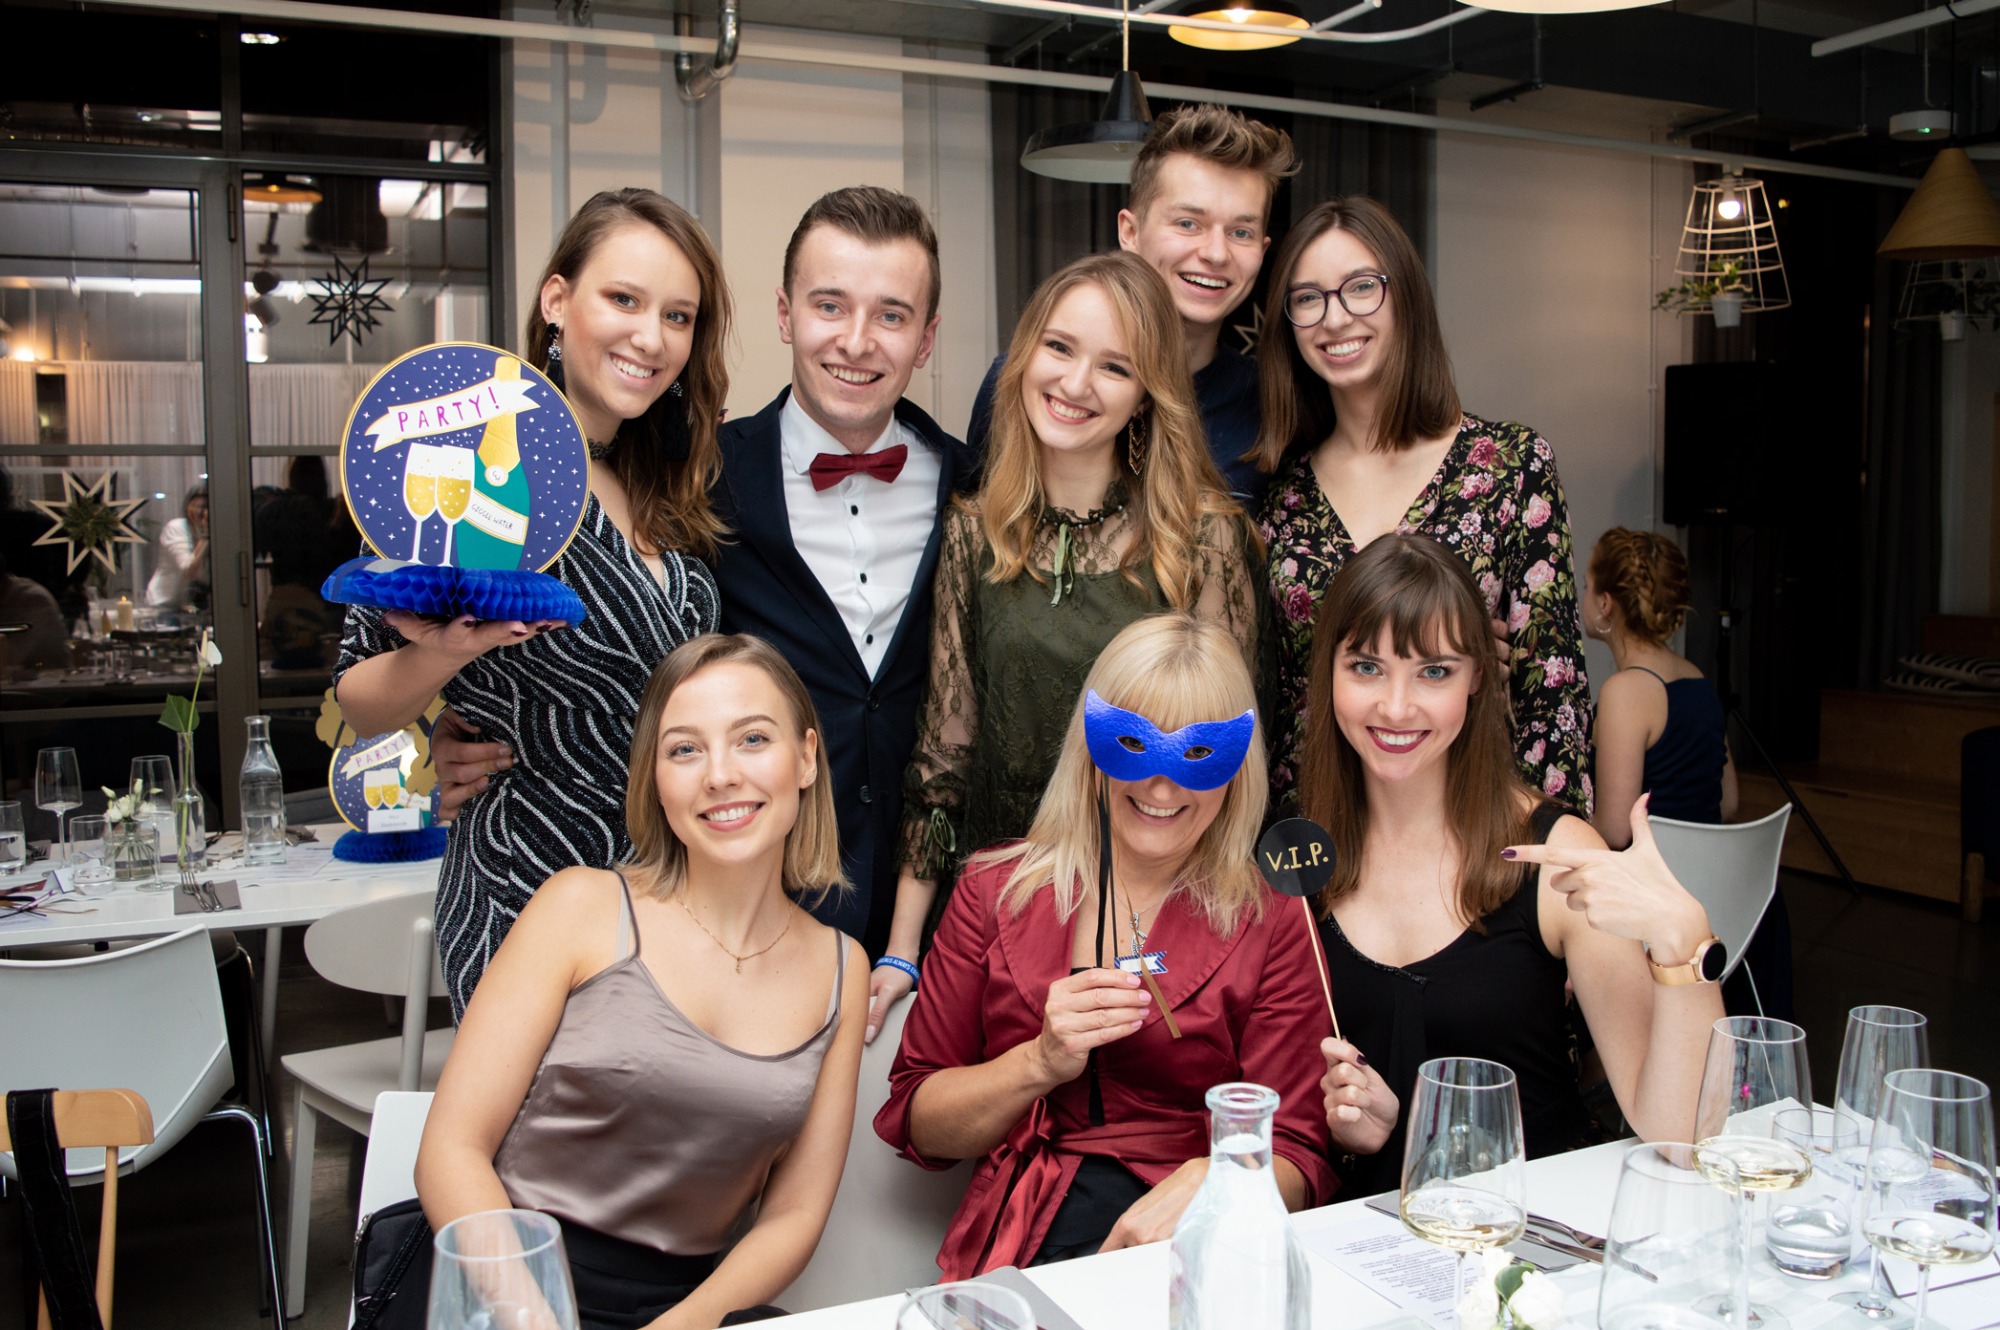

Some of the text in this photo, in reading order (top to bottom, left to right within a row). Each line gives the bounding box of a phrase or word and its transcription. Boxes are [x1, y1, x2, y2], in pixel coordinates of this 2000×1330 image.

[397, 386, 501, 433] PARTY!
[471, 504, 514, 530] GIGGLE WATER
[355, 734, 408, 767] PARTY!
[1265, 842, 1329, 872] V.I.P.
